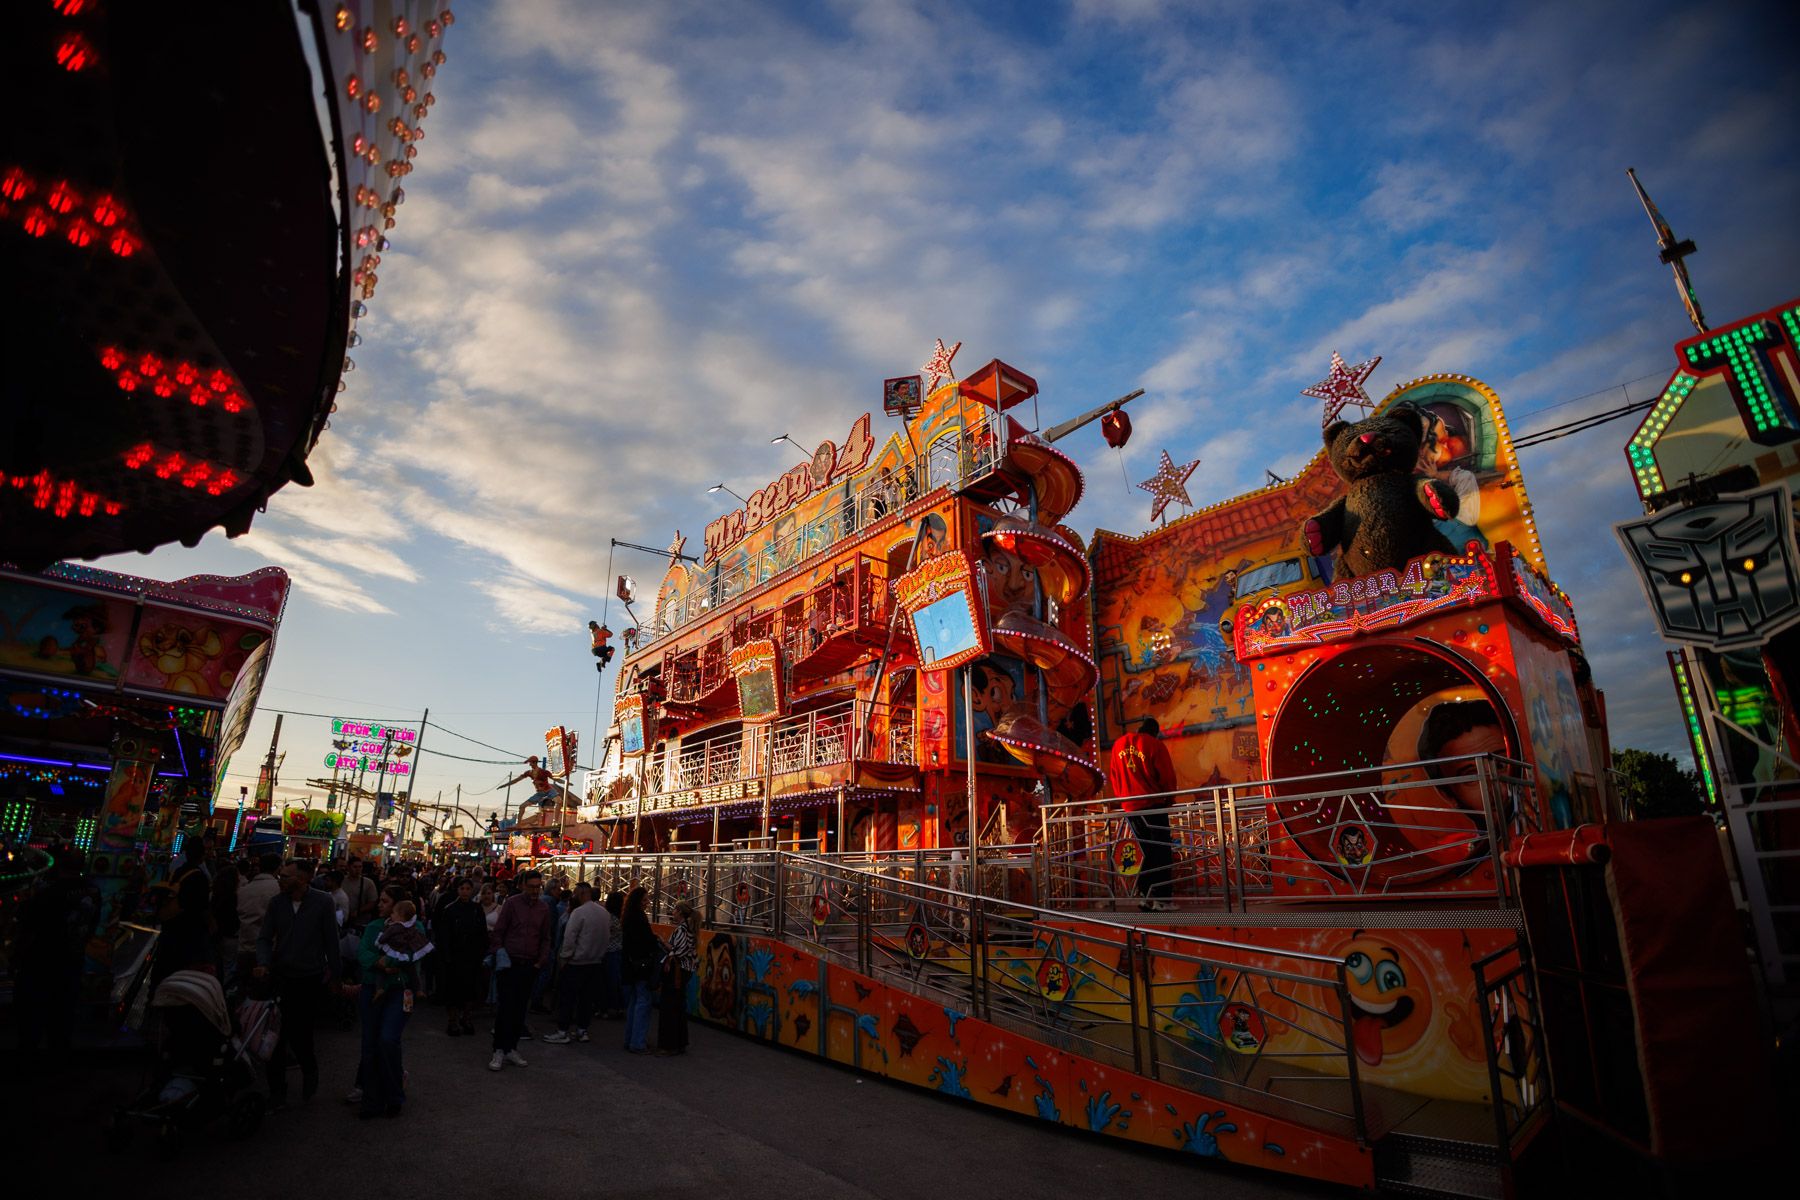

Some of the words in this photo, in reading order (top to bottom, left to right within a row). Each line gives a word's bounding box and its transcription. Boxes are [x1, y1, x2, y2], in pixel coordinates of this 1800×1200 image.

[745, 463, 812, 532] Bean
[833, 412, 875, 479] 4
[922, 555, 965, 581] Bean
[1333, 571, 1399, 606] Bean
[1401, 560, 1428, 597] 4
[333, 719, 370, 735] RATÓN
[361, 742, 384, 754] CON
[326, 754, 357, 768] GATO
[1126, 756, 1137, 773] 4
[701, 783, 744, 803] BEAN
